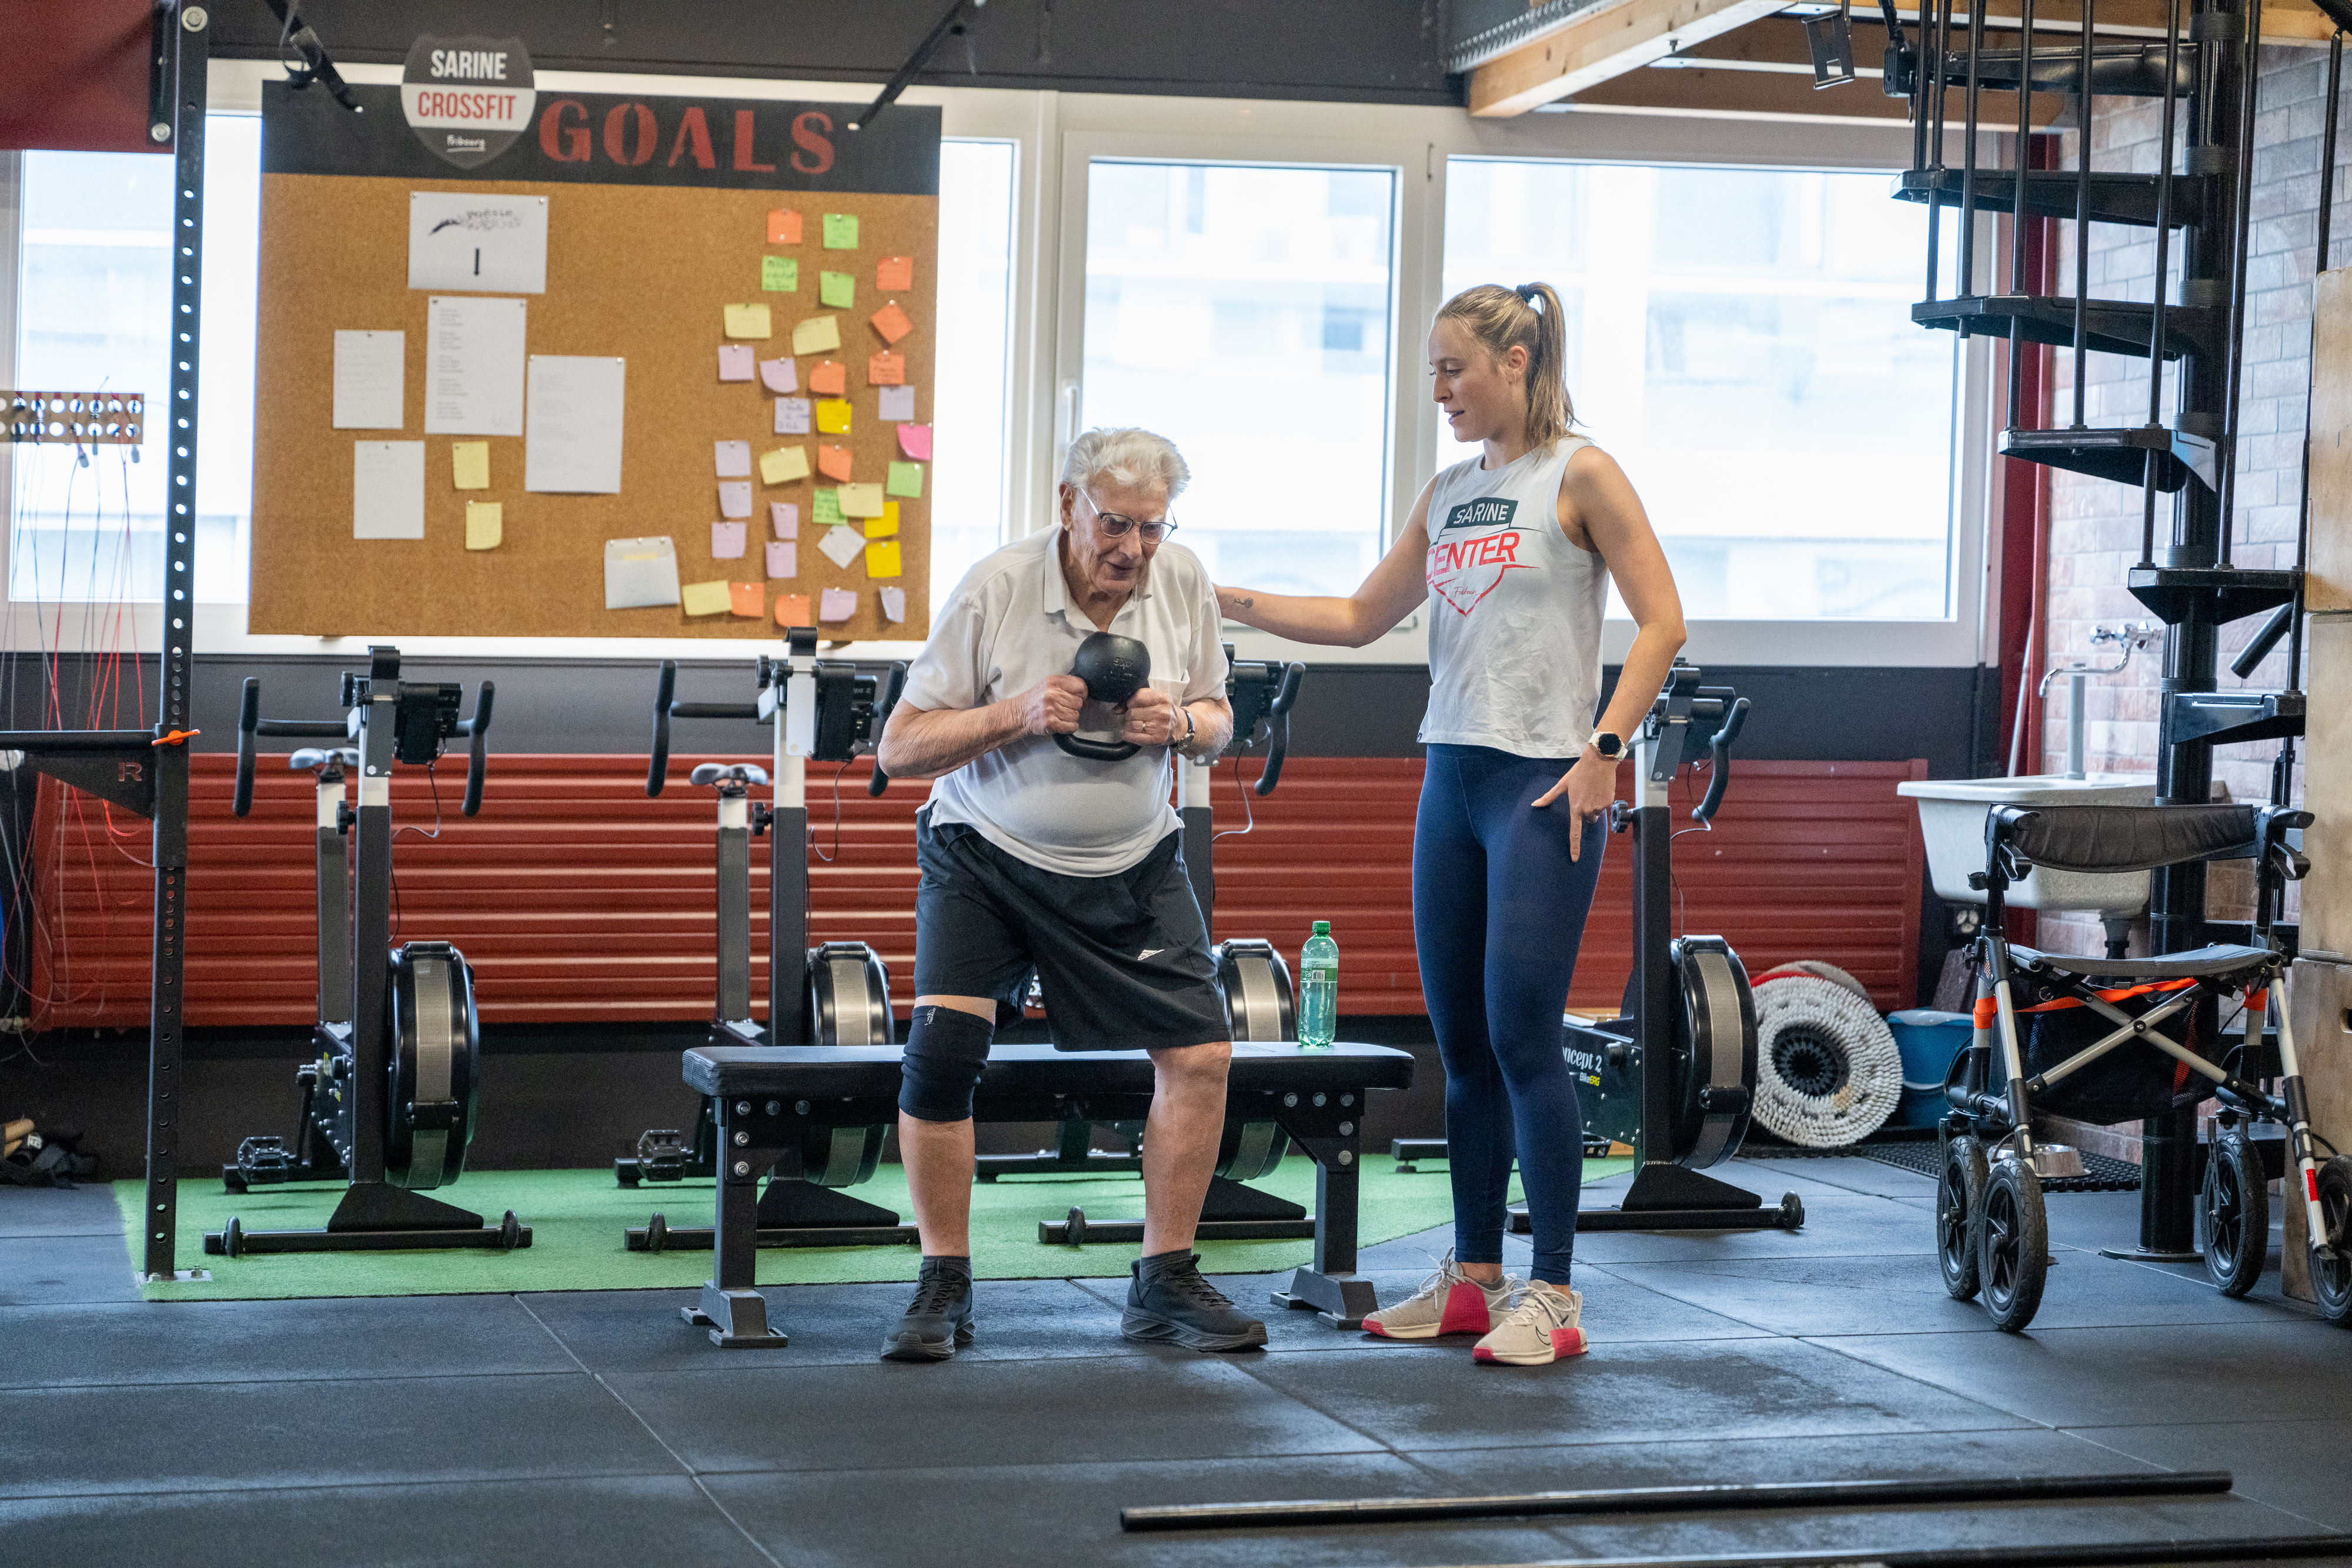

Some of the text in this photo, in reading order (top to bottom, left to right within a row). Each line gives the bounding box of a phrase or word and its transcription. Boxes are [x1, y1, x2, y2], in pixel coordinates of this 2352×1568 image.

[430, 49, 508, 81] SARINE
[417, 92, 517, 121] CROSSFIT
[539, 99, 834, 173] GOALS
[1454, 503, 1509, 524] SARINE
[1426, 533, 1519, 580] CENTER
[1562, 1047, 1602, 1073] ncept 2
